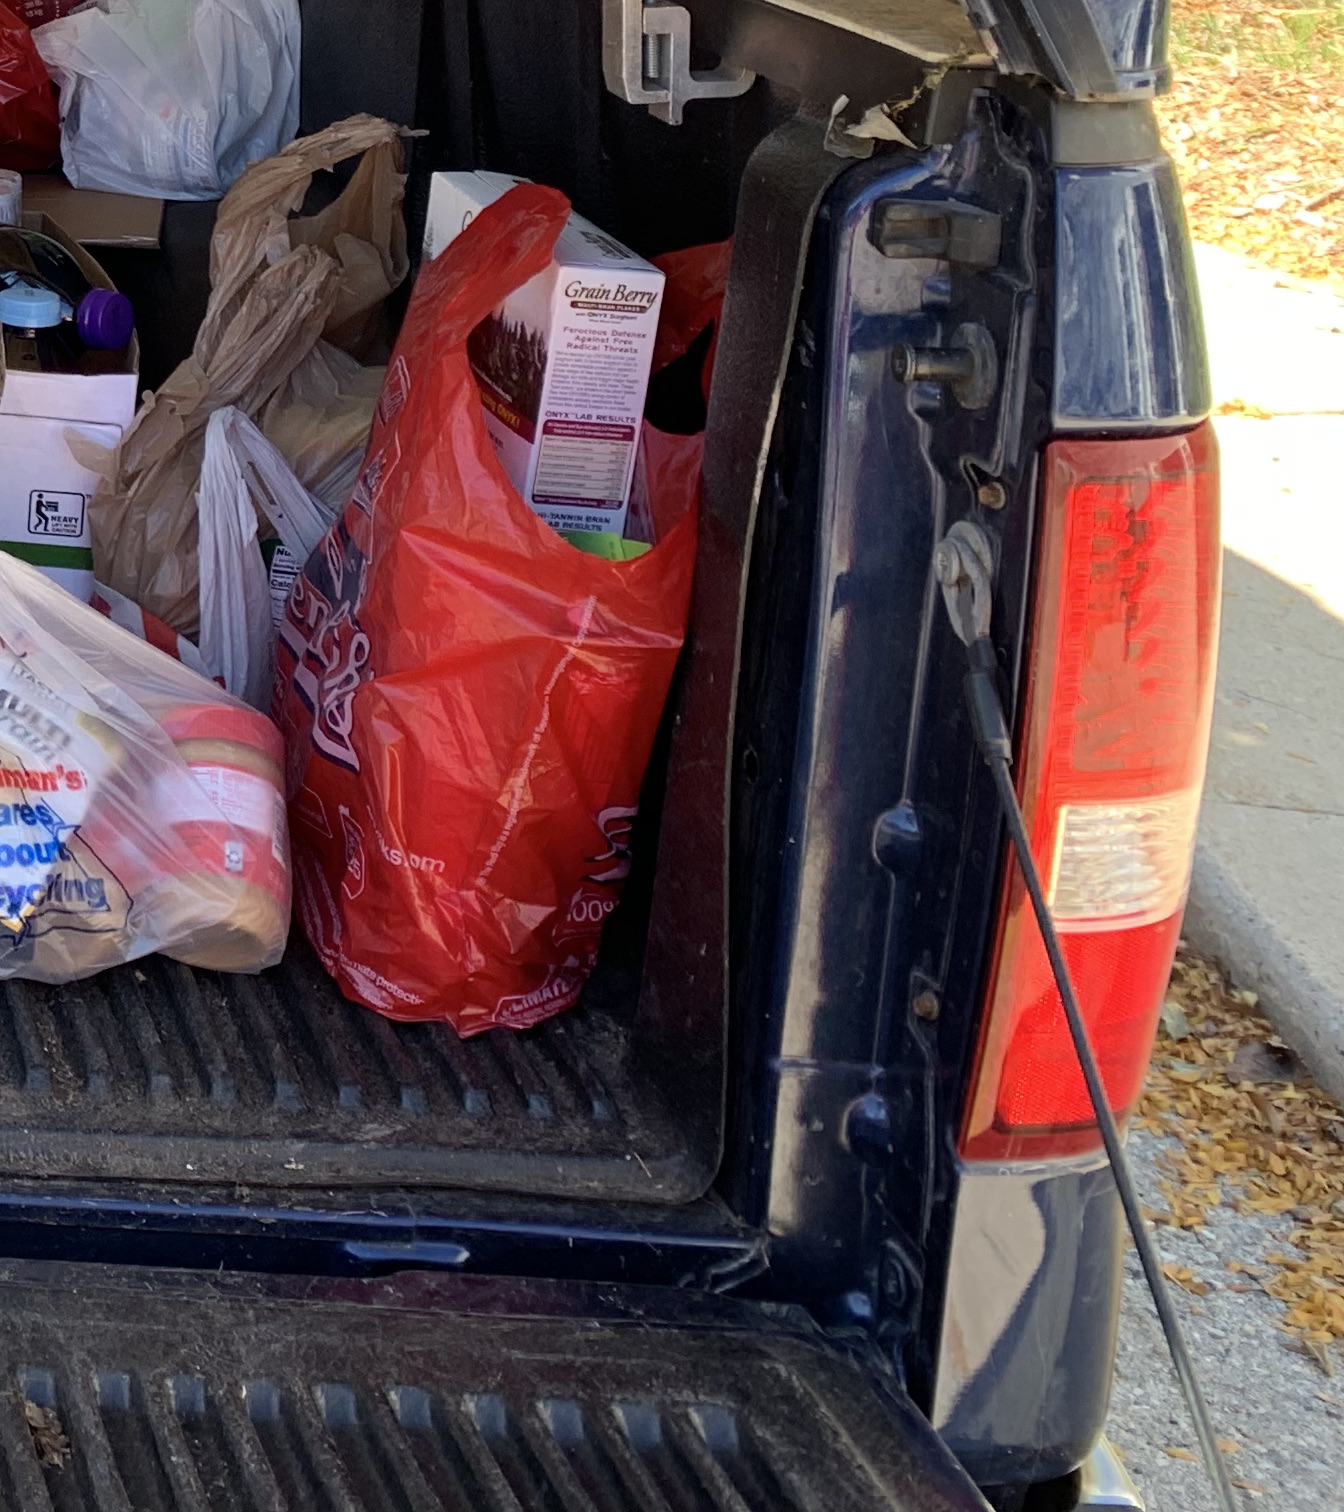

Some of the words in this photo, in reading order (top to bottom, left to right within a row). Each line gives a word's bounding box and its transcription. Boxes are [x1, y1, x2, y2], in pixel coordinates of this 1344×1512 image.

[564, 280, 611, 299] Grain
[612, 284, 659, 309] Berry
[563, 326, 607, 336] Ferocious
[611, 329, 647, 339] Defense
[574, 335, 610, 344] Against
[566, 343, 601, 351] Radical
[604, 345, 639, 354] Threats
[596, 414, 636, 424] RESULTS
[50, 515, 79, 524] HEAVY
